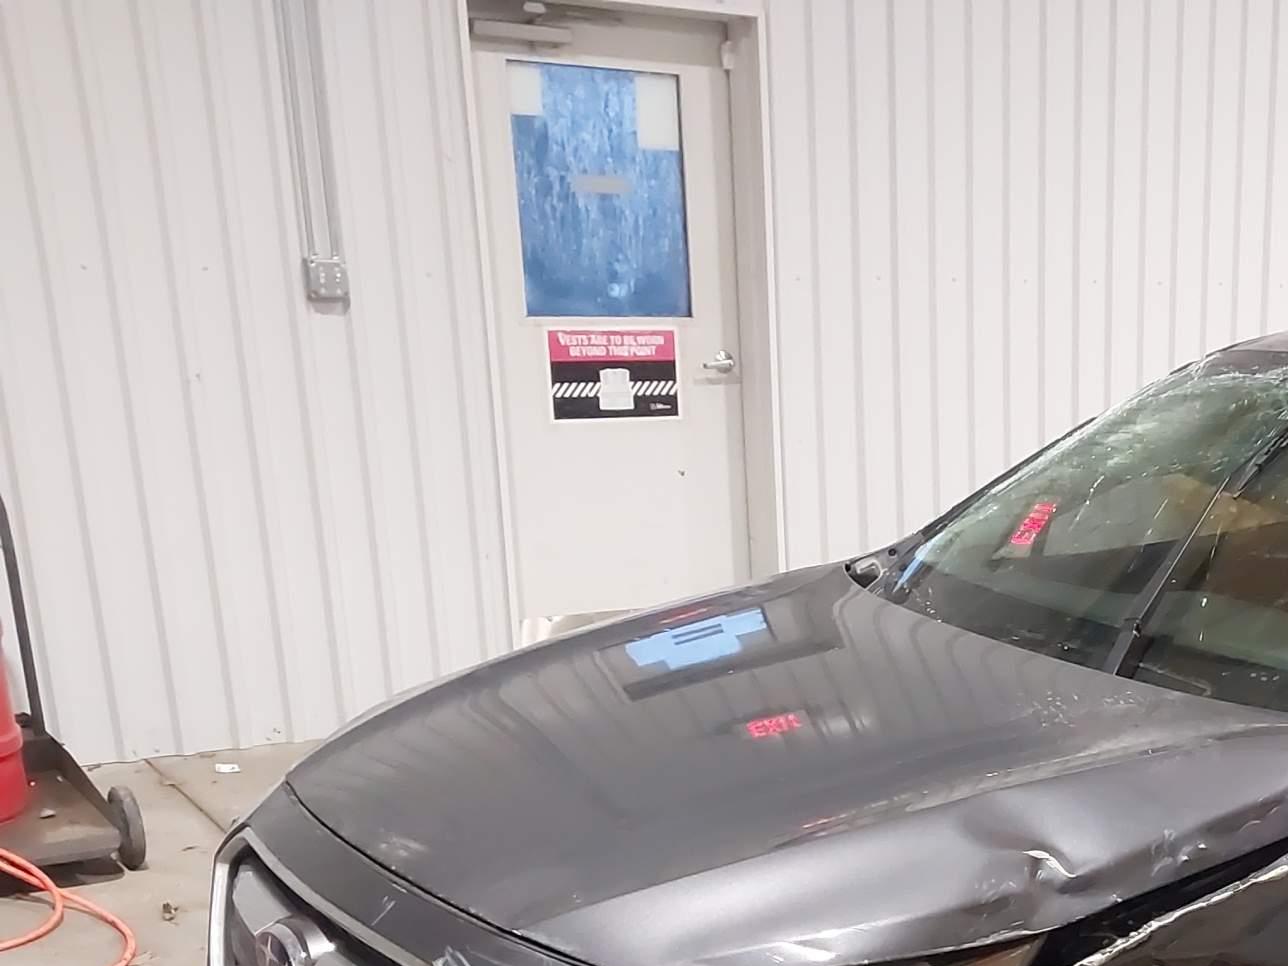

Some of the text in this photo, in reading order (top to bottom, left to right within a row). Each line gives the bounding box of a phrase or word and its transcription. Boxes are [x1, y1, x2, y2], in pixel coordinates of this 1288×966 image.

[557, 332, 589, 346] VESTS
[609, 335, 622, 345] TO
[569, 346, 607, 356] BEYOND
